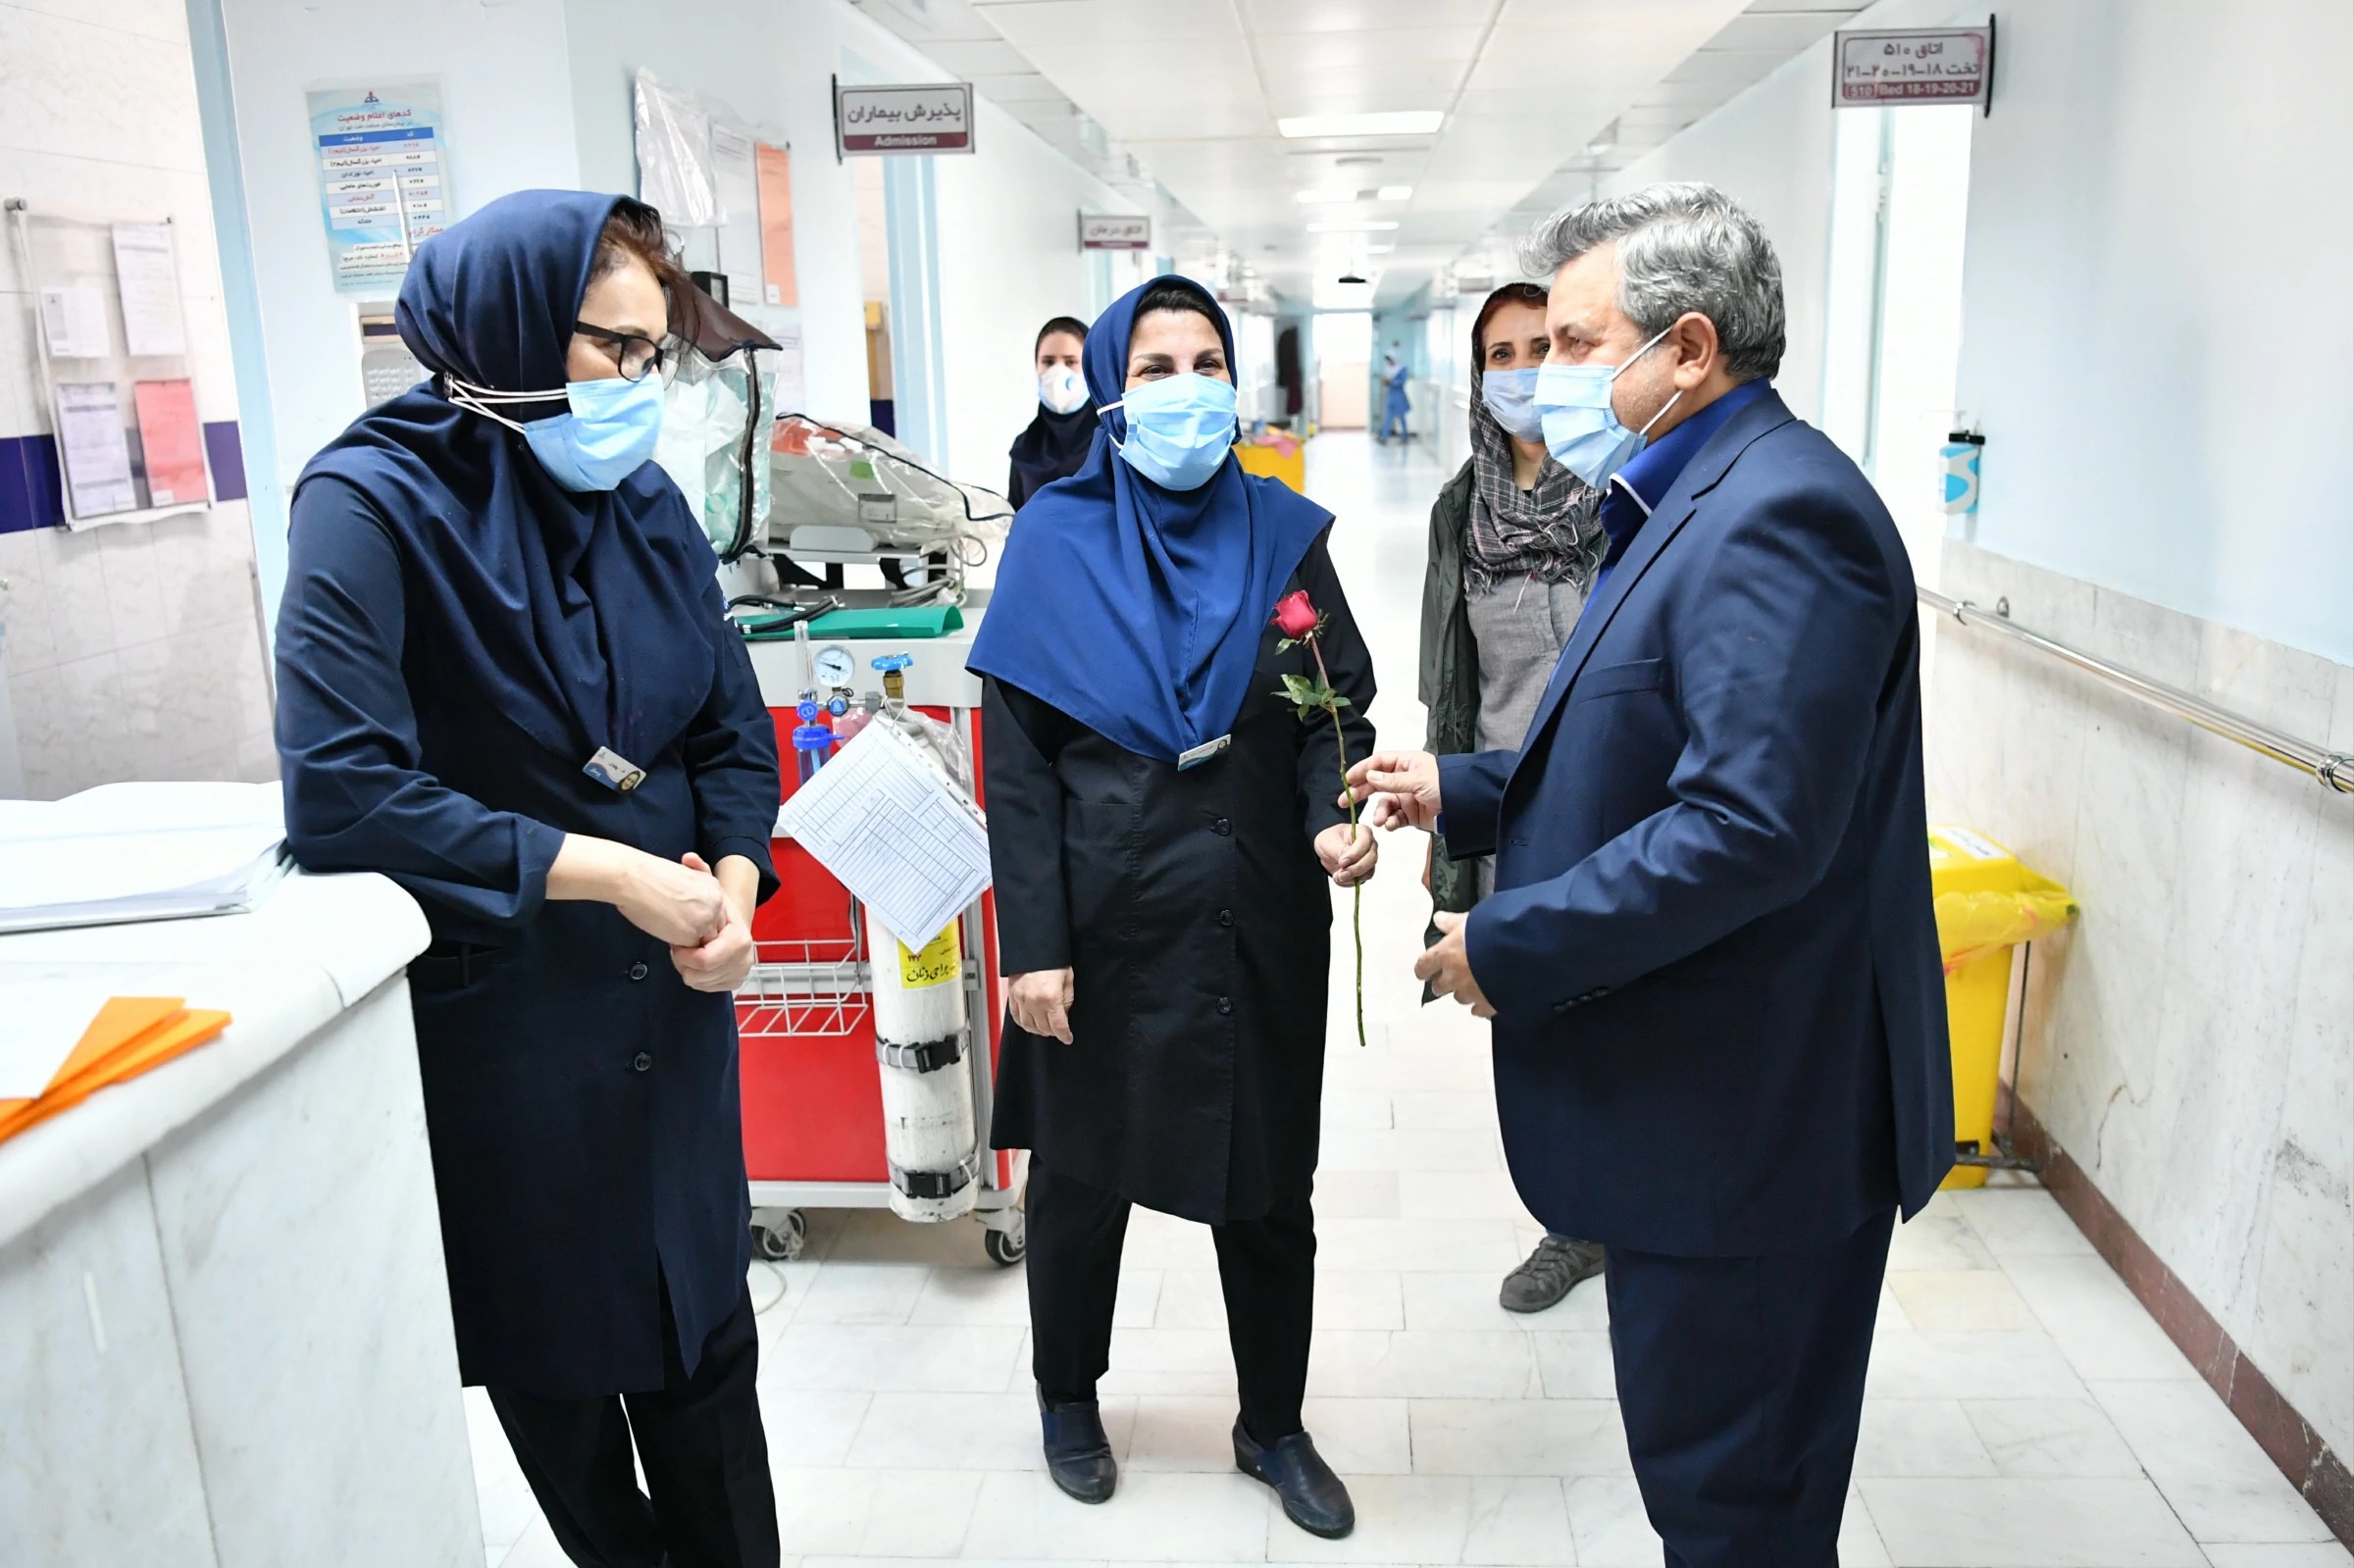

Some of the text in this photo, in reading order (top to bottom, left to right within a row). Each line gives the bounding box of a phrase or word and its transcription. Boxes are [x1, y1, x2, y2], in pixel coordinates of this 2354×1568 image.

[1915, 42, 1943, 59] اتاق
[1946, 62, 1979, 75] تخت
[1879, 84, 1904, 95] Bed
[847, 102, 961, 124] پذیرش بیماران
[875, 135, 937, 146] Admission
